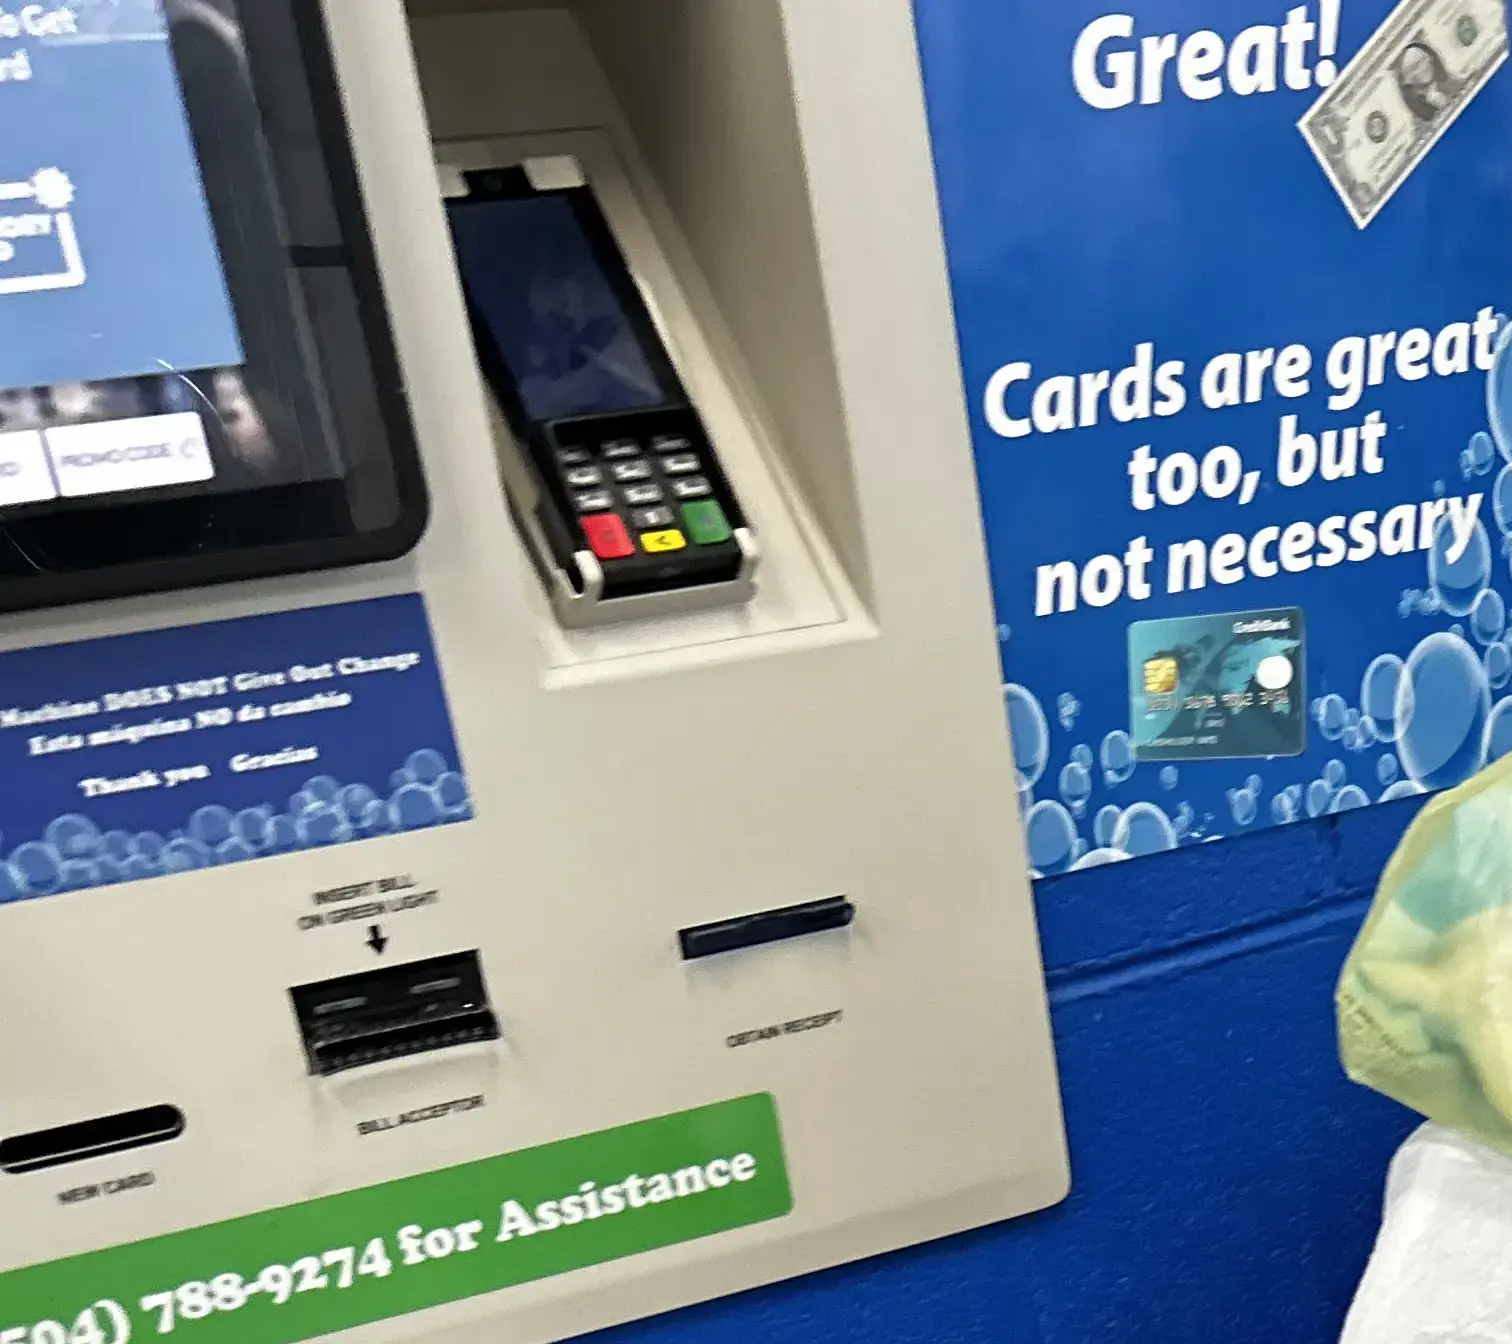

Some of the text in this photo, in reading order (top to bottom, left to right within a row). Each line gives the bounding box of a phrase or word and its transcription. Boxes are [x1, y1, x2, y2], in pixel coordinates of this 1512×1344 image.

[1071, 0, 1342, 110] Great!
[984, 306, 1500, 438] Cards are great
[1127, 411, 1388, 511] too, but
[1033, 493, 1484, 617] not necessary
[103, 685, 173, 712] DOES
[174, 676, 228, 701] NOT
[233, 671, 286, 691] Give
[337, 652, 420, 676] Change
[194, 707, 233, 730] NO
[77, 769, 162, 797] Thank
[230, 746, 320, 773] Gracias
[326, 901, 386, 924] GREEN
[389, 889, 439, 912] LIGHT
[356, 1093, 485, 1136] BILL ACCEPTOR
[57, 1170, 156, 1204] NEW CARD
[140, 1237, 393, 1335] 788-9274
[396, 1223, 482, 1266] for
[495, 1152, 757, 1243] Assistance
